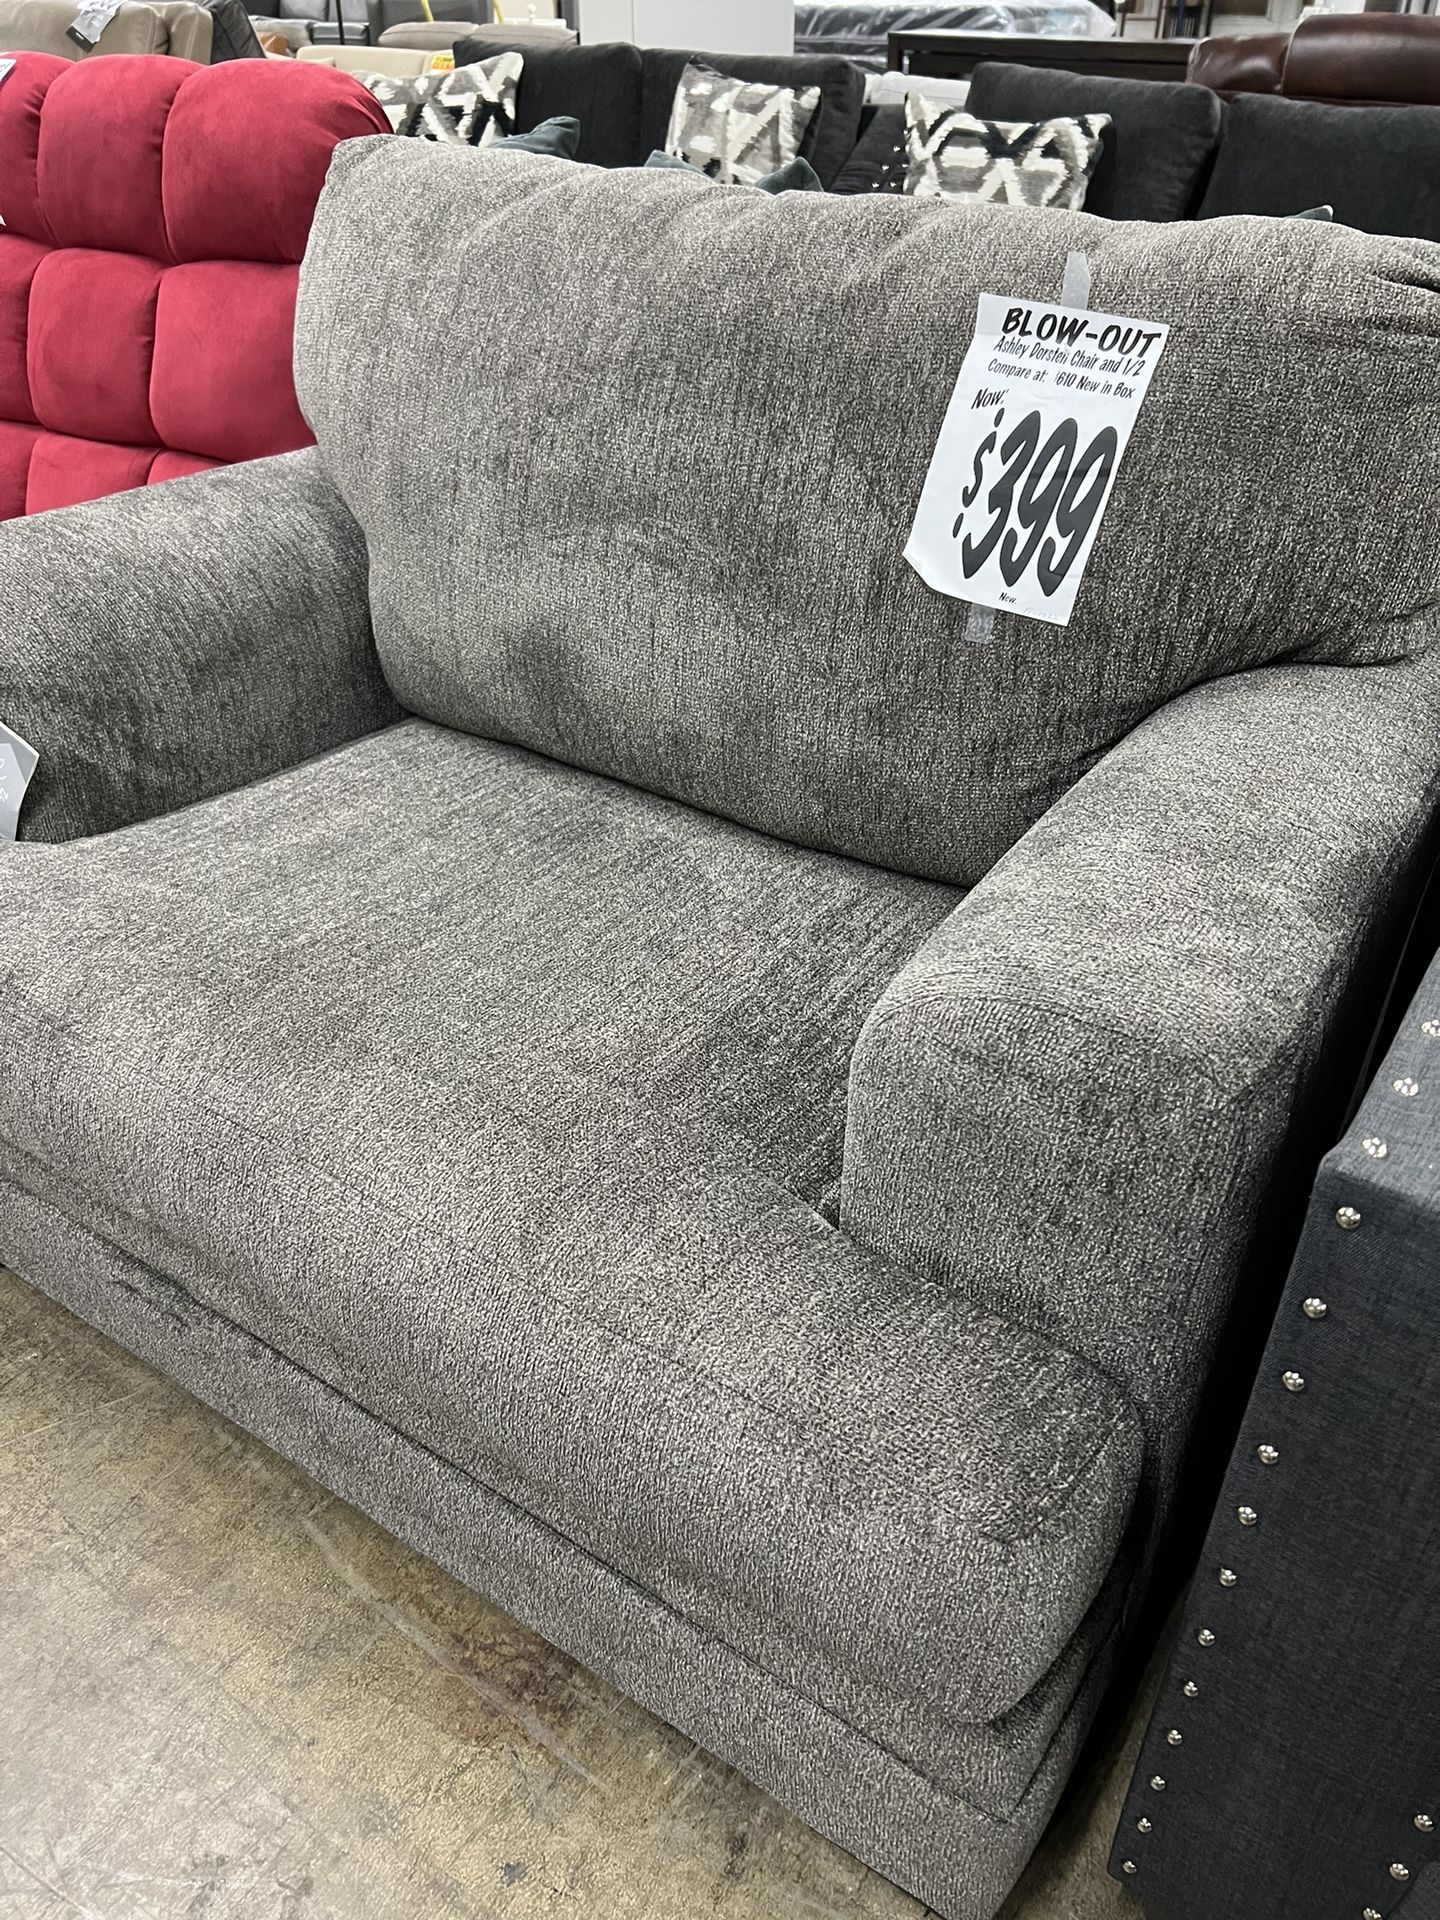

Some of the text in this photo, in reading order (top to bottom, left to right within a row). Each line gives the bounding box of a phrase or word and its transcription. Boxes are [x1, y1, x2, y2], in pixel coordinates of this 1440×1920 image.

[1002, 308, 1161, 357] BLOW-OUT
[988, 358, 1031, 379] Compare
[1075, 376, 1099, 393] New
[1100, 380, 1112, 395] in
[1113, 382, 1136, 399] Box
[994, 335, 1029, 359] Ashley
[1070, 350, 1099, 370] Chair
[1099, 357, 1124, 373] and
[1121, 358, 1145, 377] 1/2
[952, 408, 1118, 597] $399
